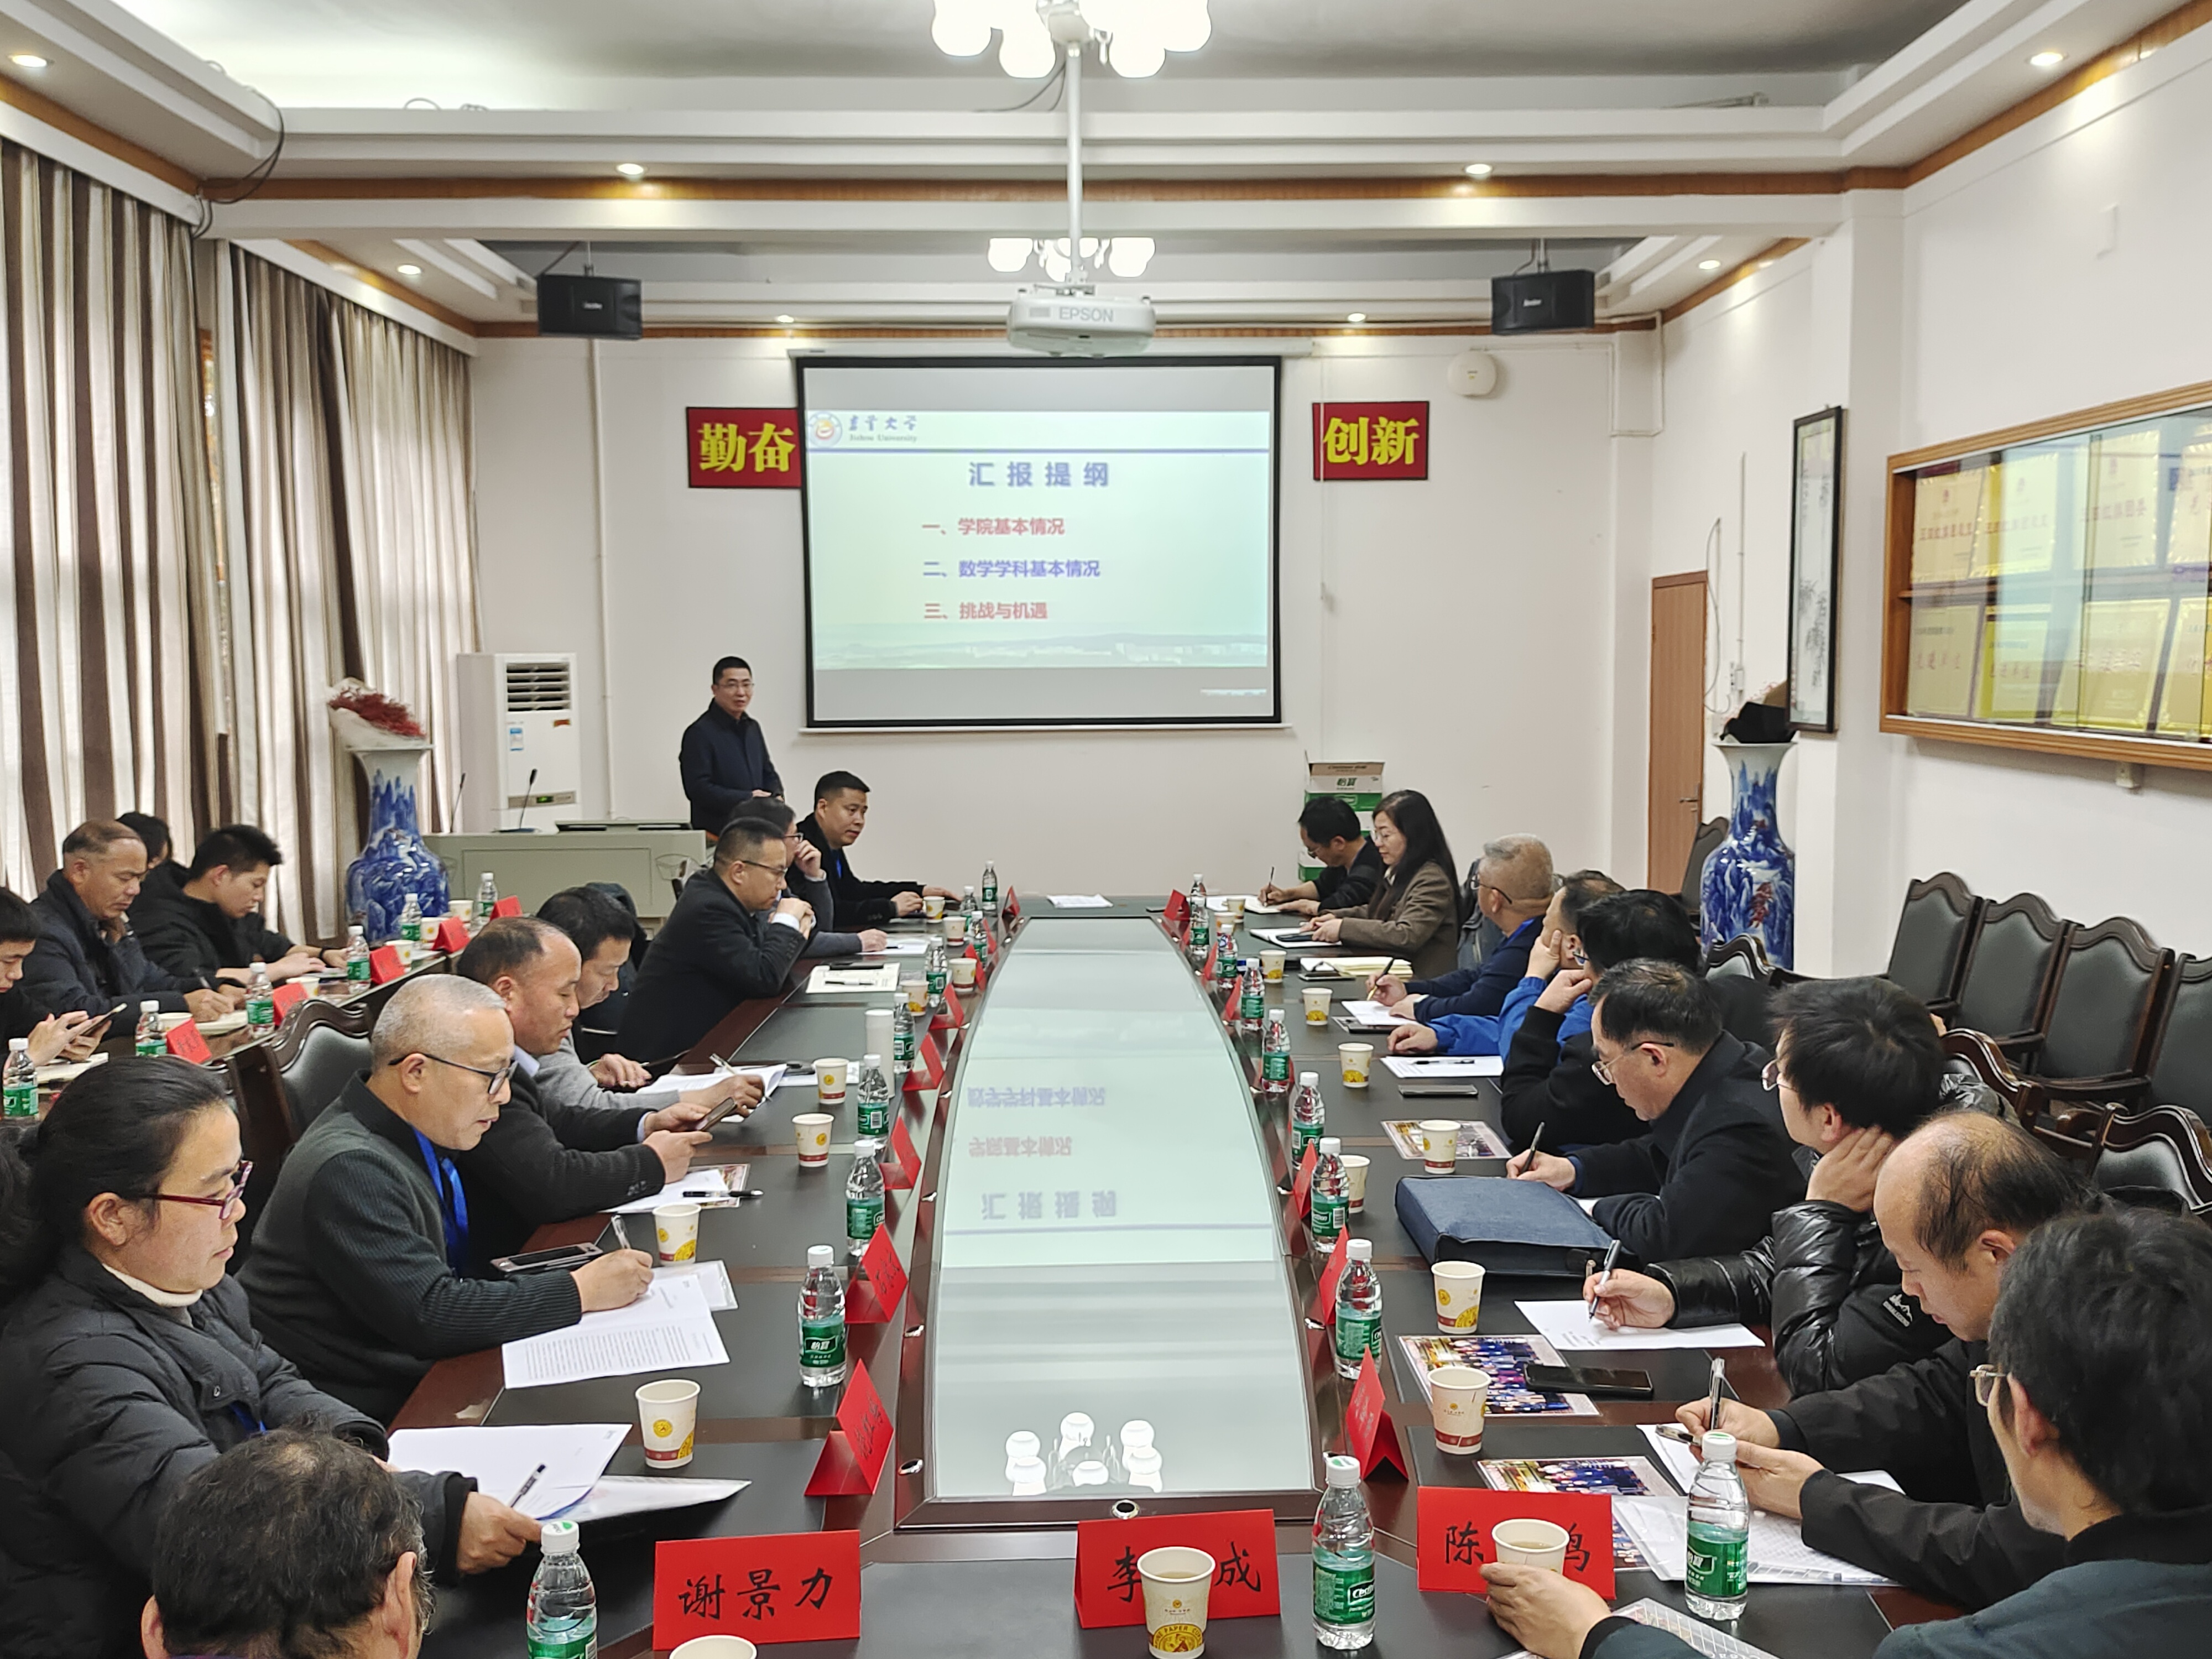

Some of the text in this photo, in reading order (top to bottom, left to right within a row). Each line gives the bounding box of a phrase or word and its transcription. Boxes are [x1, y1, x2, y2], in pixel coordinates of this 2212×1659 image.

[1059, 306, 1114, 322] EPSON
[697, 422, 795, 472] 勤奋
[1323, 416, 1420, 465] 创新
[969, 462, 1109, 487] 汇报提纲
[922, 518, 1066, 535] 一、学院基本情况
[923, 560, 1101, 577] 二、数学学科基本情况
[924, 602, 1048, 620] 三、挑战与机遇
[1107, 1541, 1261, 1603] 李成
[679, 1567, 833, 1620] 谢景力
